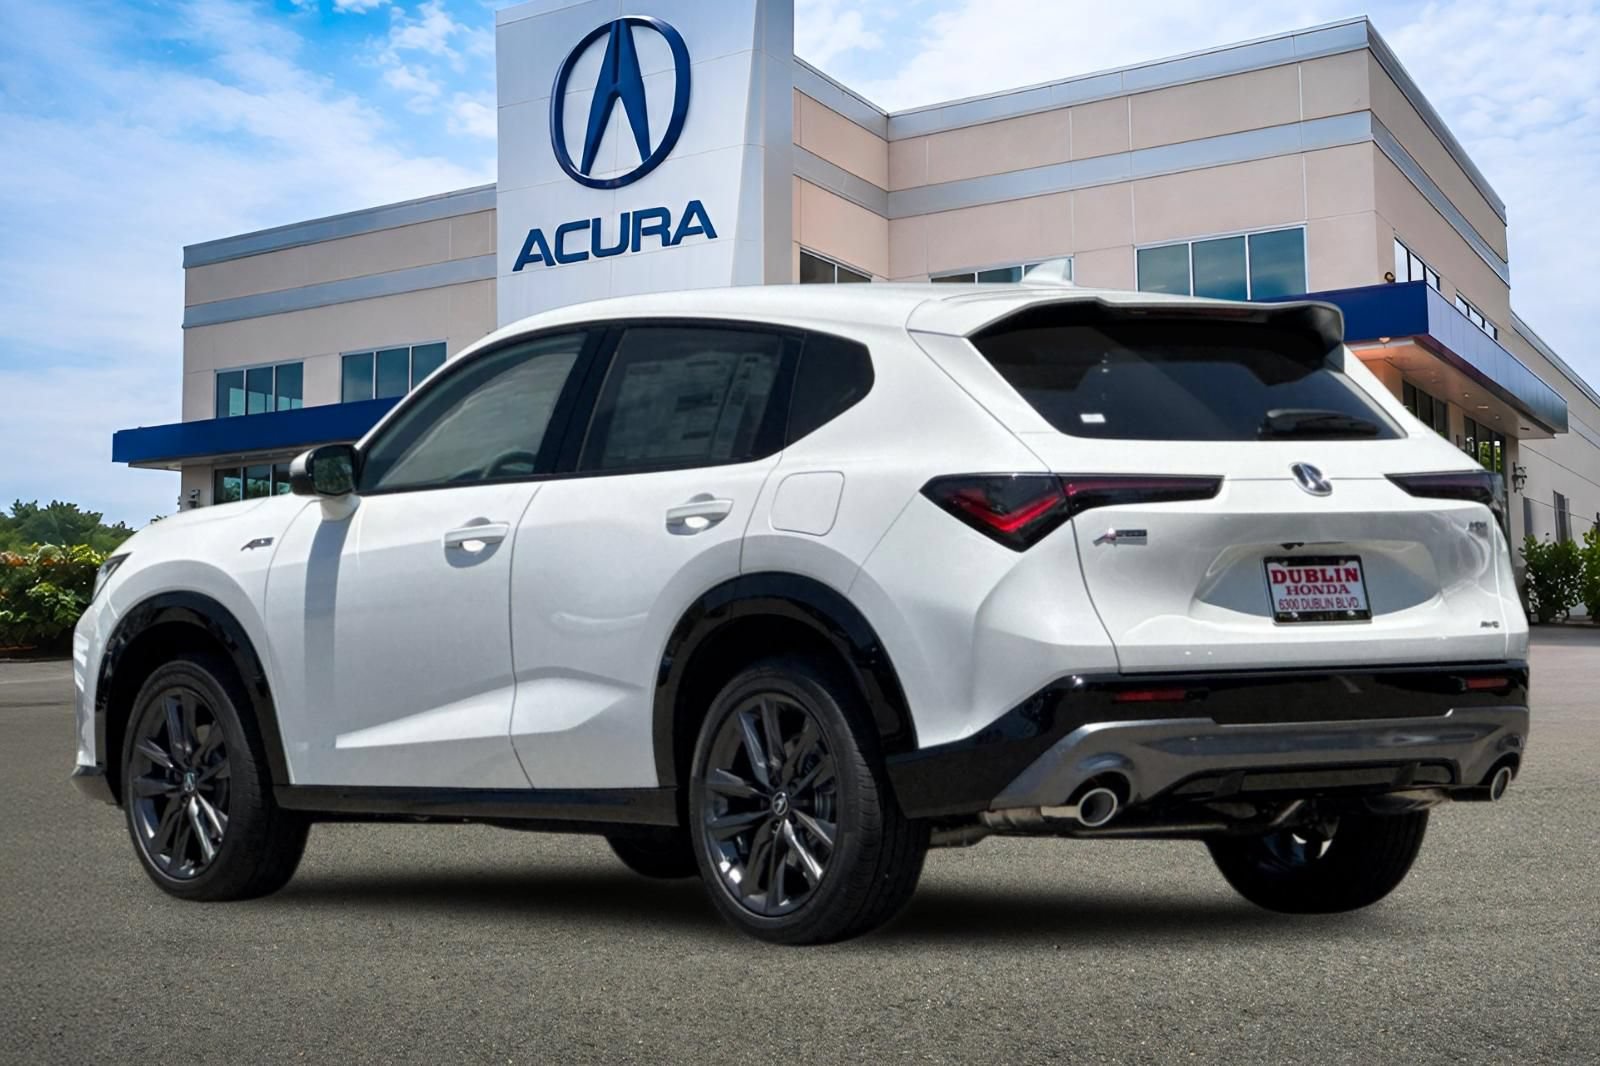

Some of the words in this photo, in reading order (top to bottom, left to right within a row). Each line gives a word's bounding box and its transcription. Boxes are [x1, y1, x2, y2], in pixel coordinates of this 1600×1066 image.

[512, 200, 718, 272] ACURA
[1271, 568, 1359, 584] DUBLIN
[1285, 584, 1351, 596] HONDA
[1279, 598, 1299, 610] 6300
[1301, 597, 1334, 609] DUBLIN
